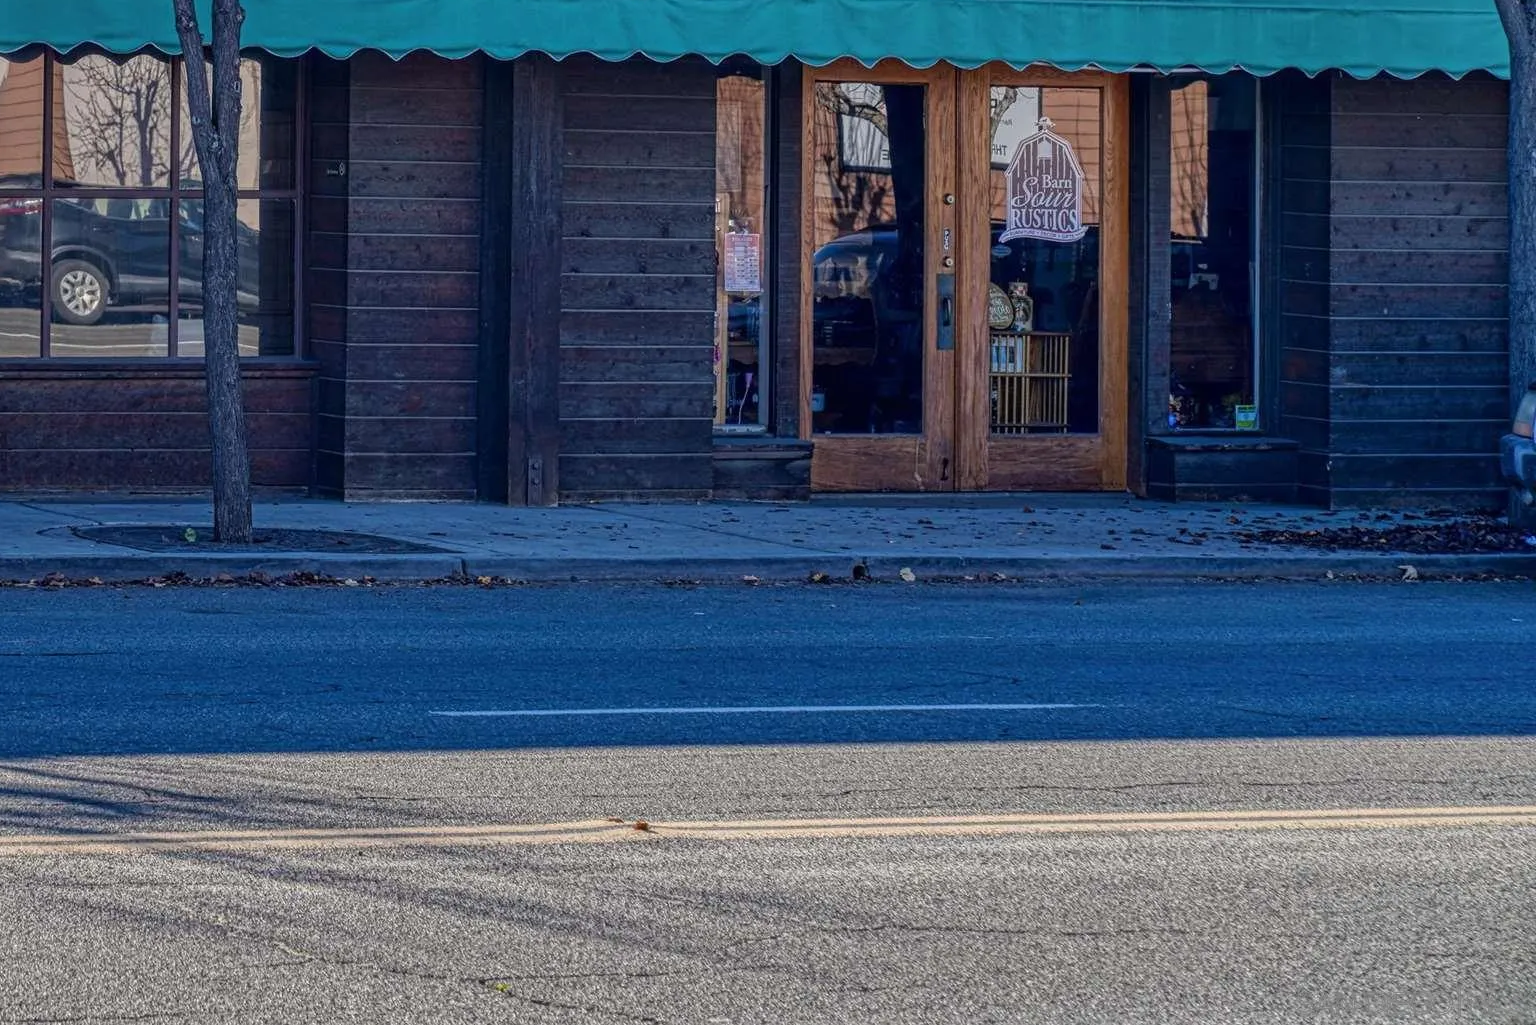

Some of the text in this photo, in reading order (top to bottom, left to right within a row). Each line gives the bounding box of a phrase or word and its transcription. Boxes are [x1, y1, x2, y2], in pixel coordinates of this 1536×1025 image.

[1012, 176, 1077, 208] Sour
[1041, 174, 1073, 189] Barn
[1012, 208, 1077, 232] RUSTICS
